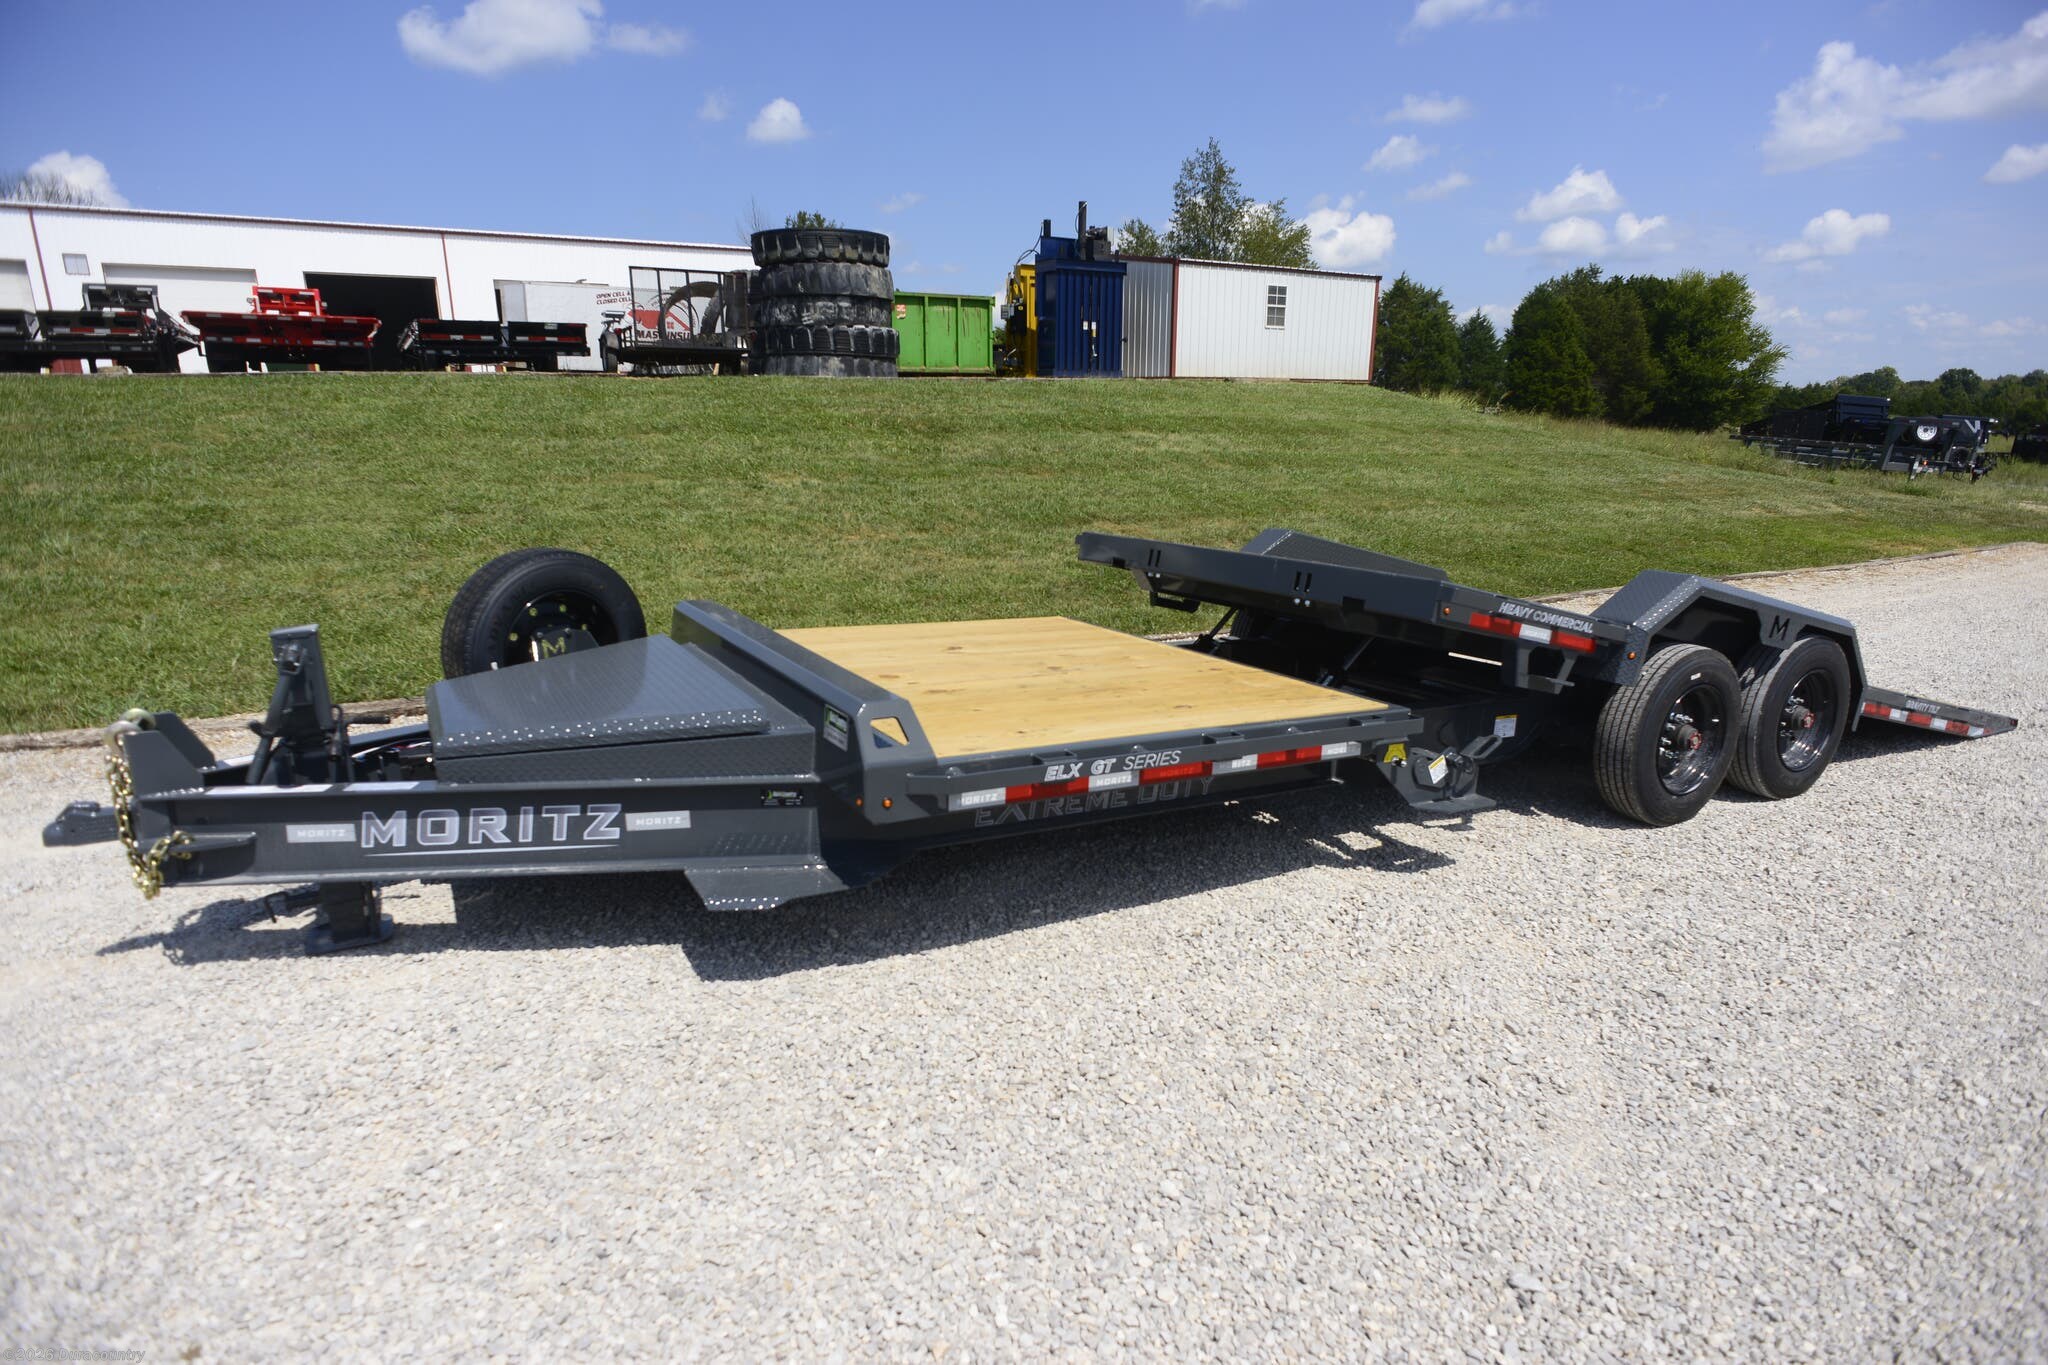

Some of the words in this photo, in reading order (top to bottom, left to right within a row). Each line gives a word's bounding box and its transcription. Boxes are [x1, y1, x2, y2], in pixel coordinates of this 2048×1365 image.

[1498, 601, 1535, 619] HEAVY
[1533, 611, 1594, 633] COMMERCIAL
[1044, 762, 1083, 781] ELX
[1090, 758, 1117, 775] GT
[1123, 750, 1182, 770] SERIES
[296, 829, 347, 839] MORITZ
[360, 802, 623, 848] MORITZ
[635, 816, 681, 826] MORITZ
